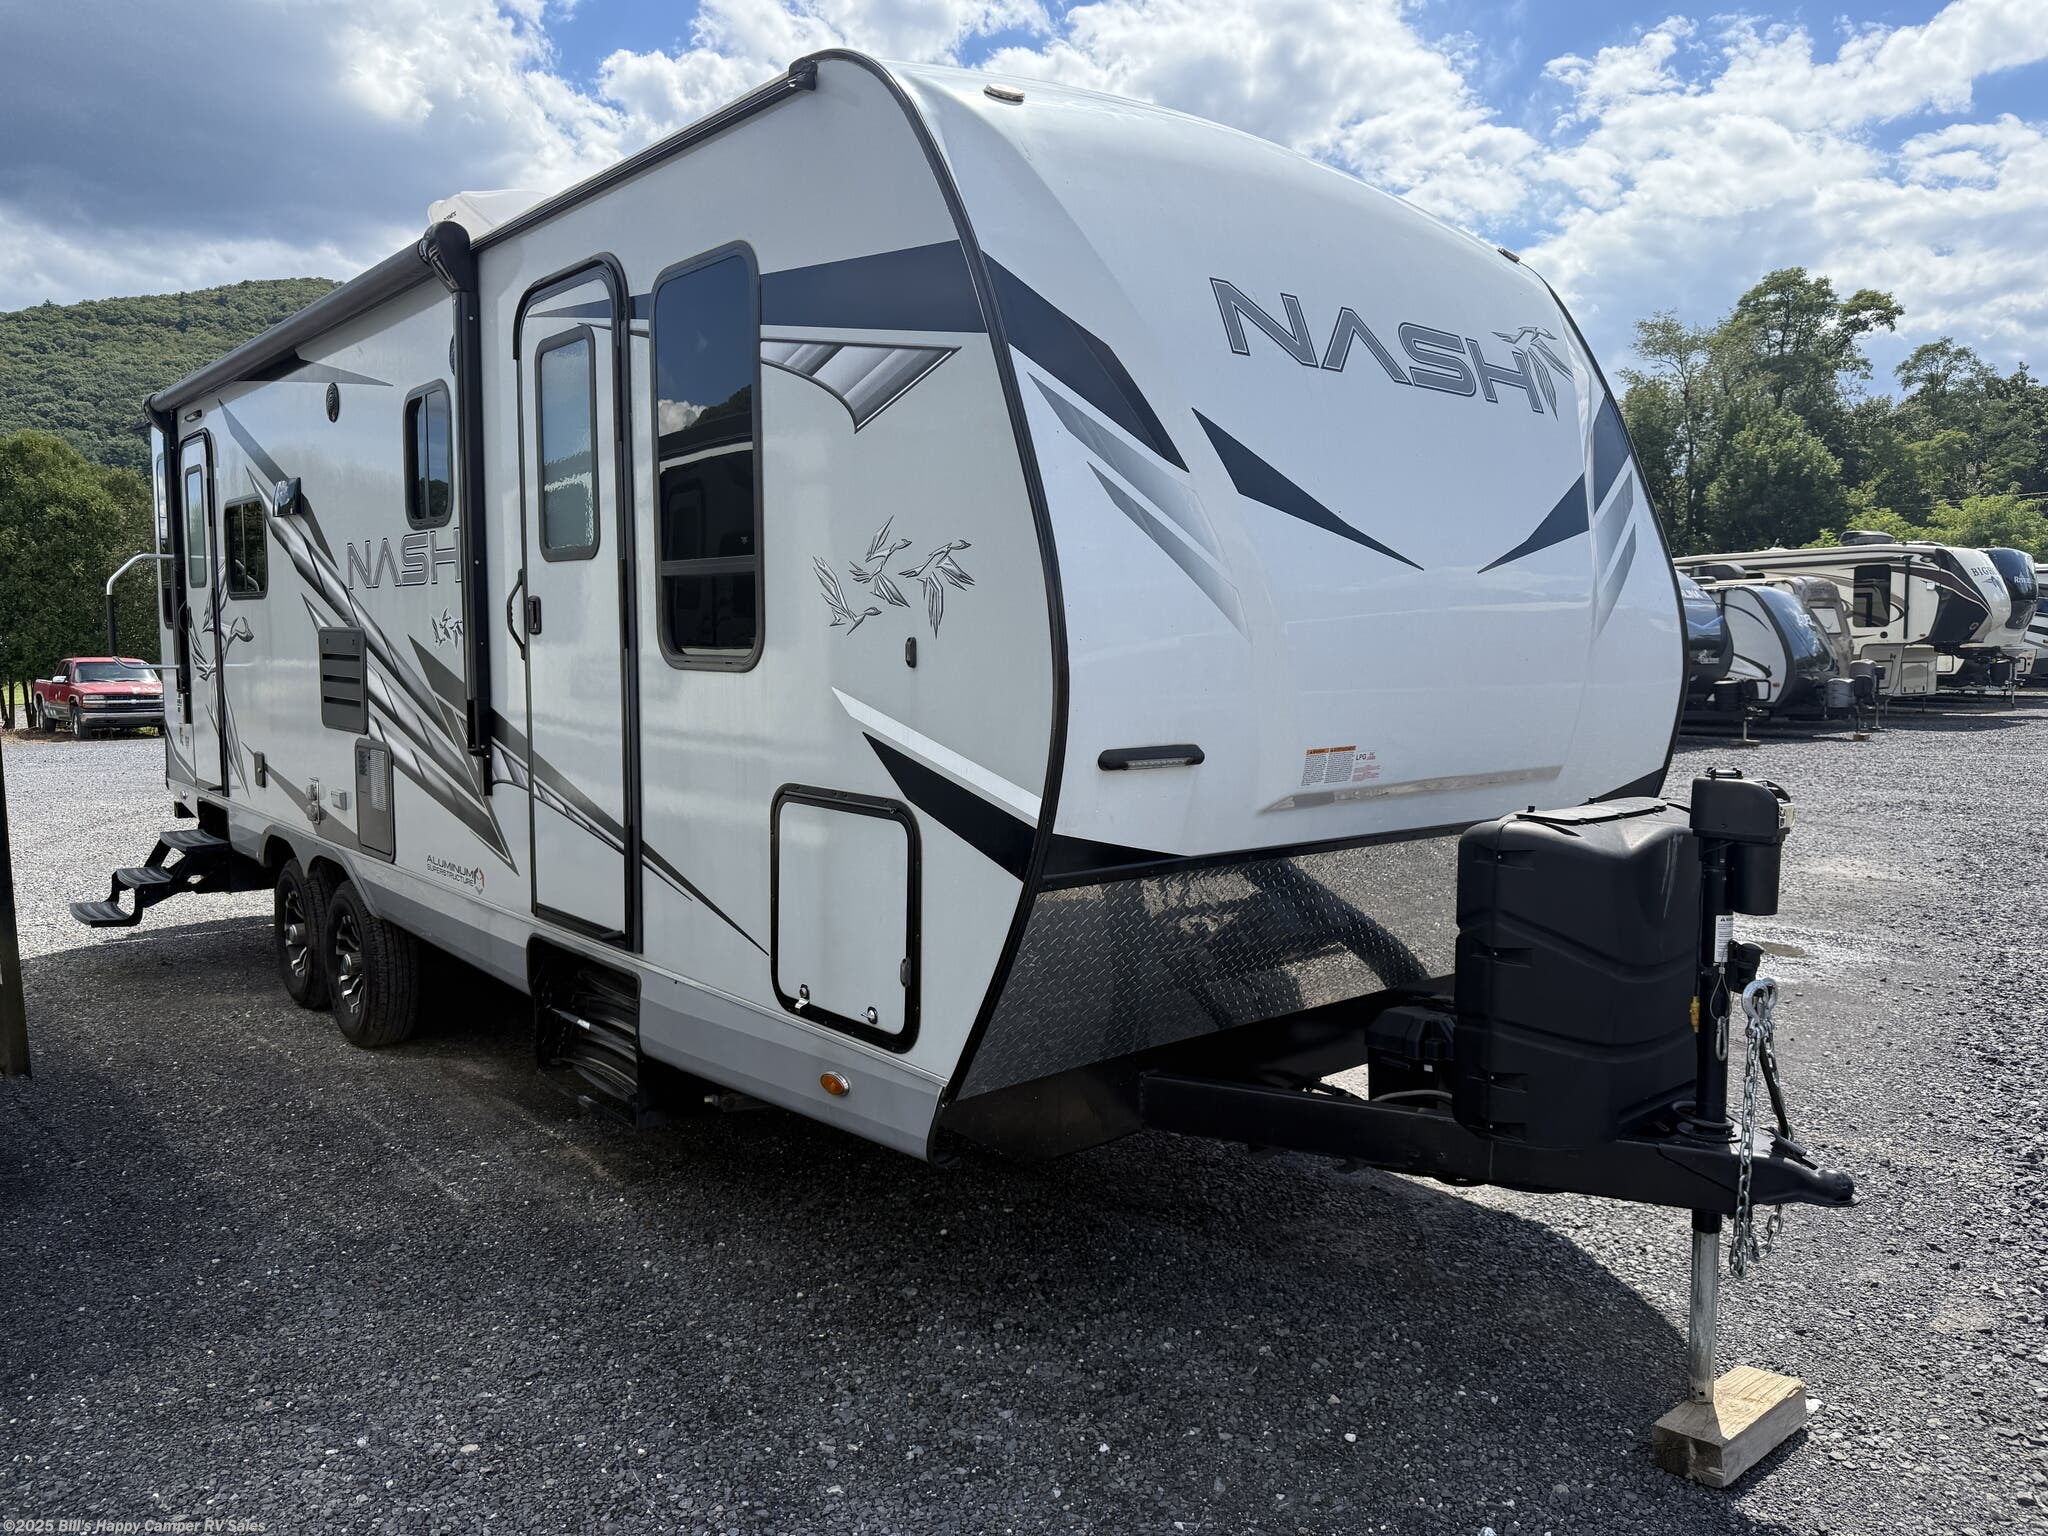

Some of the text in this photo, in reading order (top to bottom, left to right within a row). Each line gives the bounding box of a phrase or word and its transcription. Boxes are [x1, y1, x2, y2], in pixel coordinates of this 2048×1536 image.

[1209, 276, 1544, 414] NASH
[347, 526, 462, 590] NASH
[426, 854, 474, 878] ALUMINUM
[426, 863, 474, 887] SUPERSTRUCTURE
